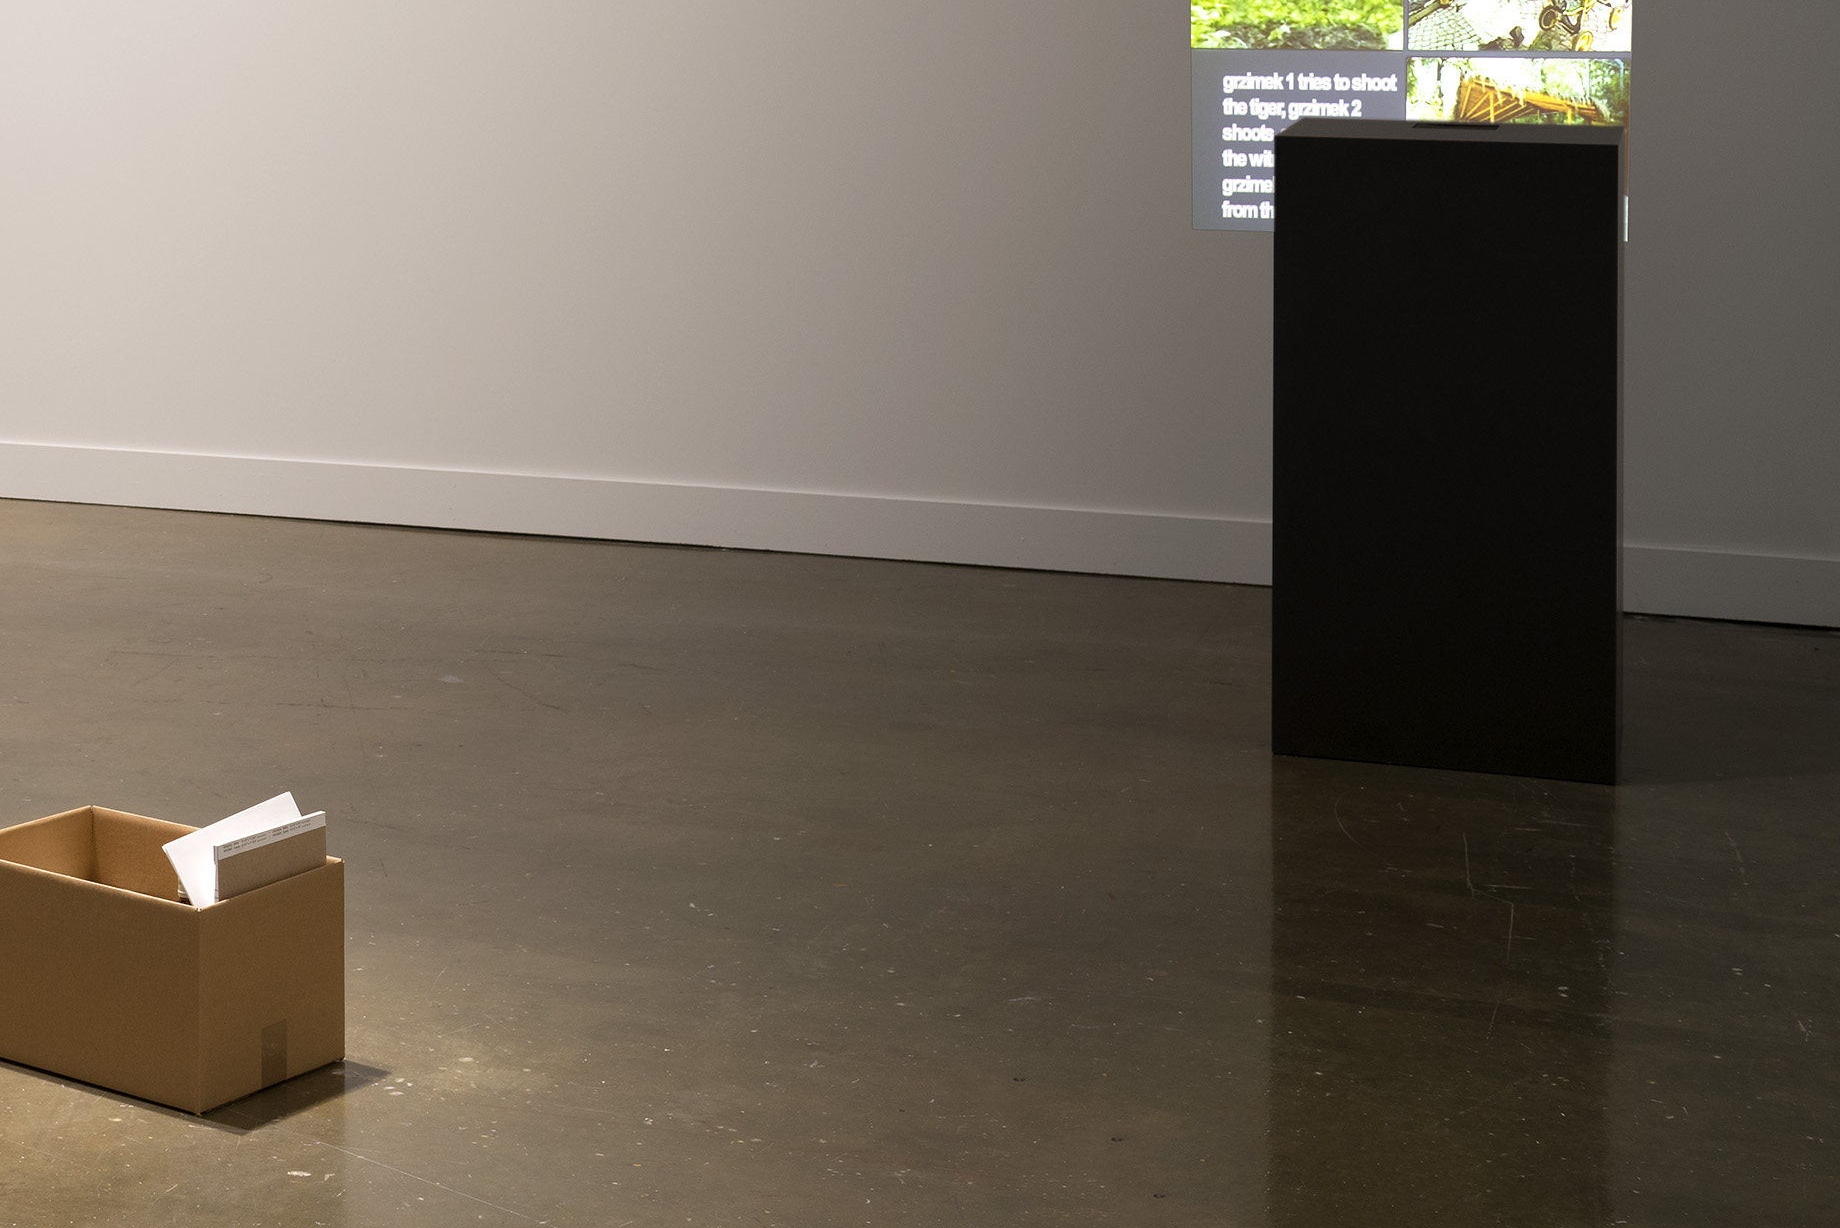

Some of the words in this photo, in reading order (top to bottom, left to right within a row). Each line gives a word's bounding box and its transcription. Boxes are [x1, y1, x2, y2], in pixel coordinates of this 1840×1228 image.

[1222, 72, 1284, 93] grzimek
[1285, 72, 1295, 90] 1
[1297, 72, 1332, 91] tries
[1333, 73, 1351, 91] to
[1351, 73, 1398, 92] shoot
[1222, 97, 1248, 116] the
[1249, 97, 1287, 120] tiger,
[1288, 98, 1350, 120] grzimek
[1350, 99, 1362, 117] 2
[1222, 123, 1275, 142] shoots
[1222, 148, 1248, 167] the
[1222, 200, 1259, 218] from
